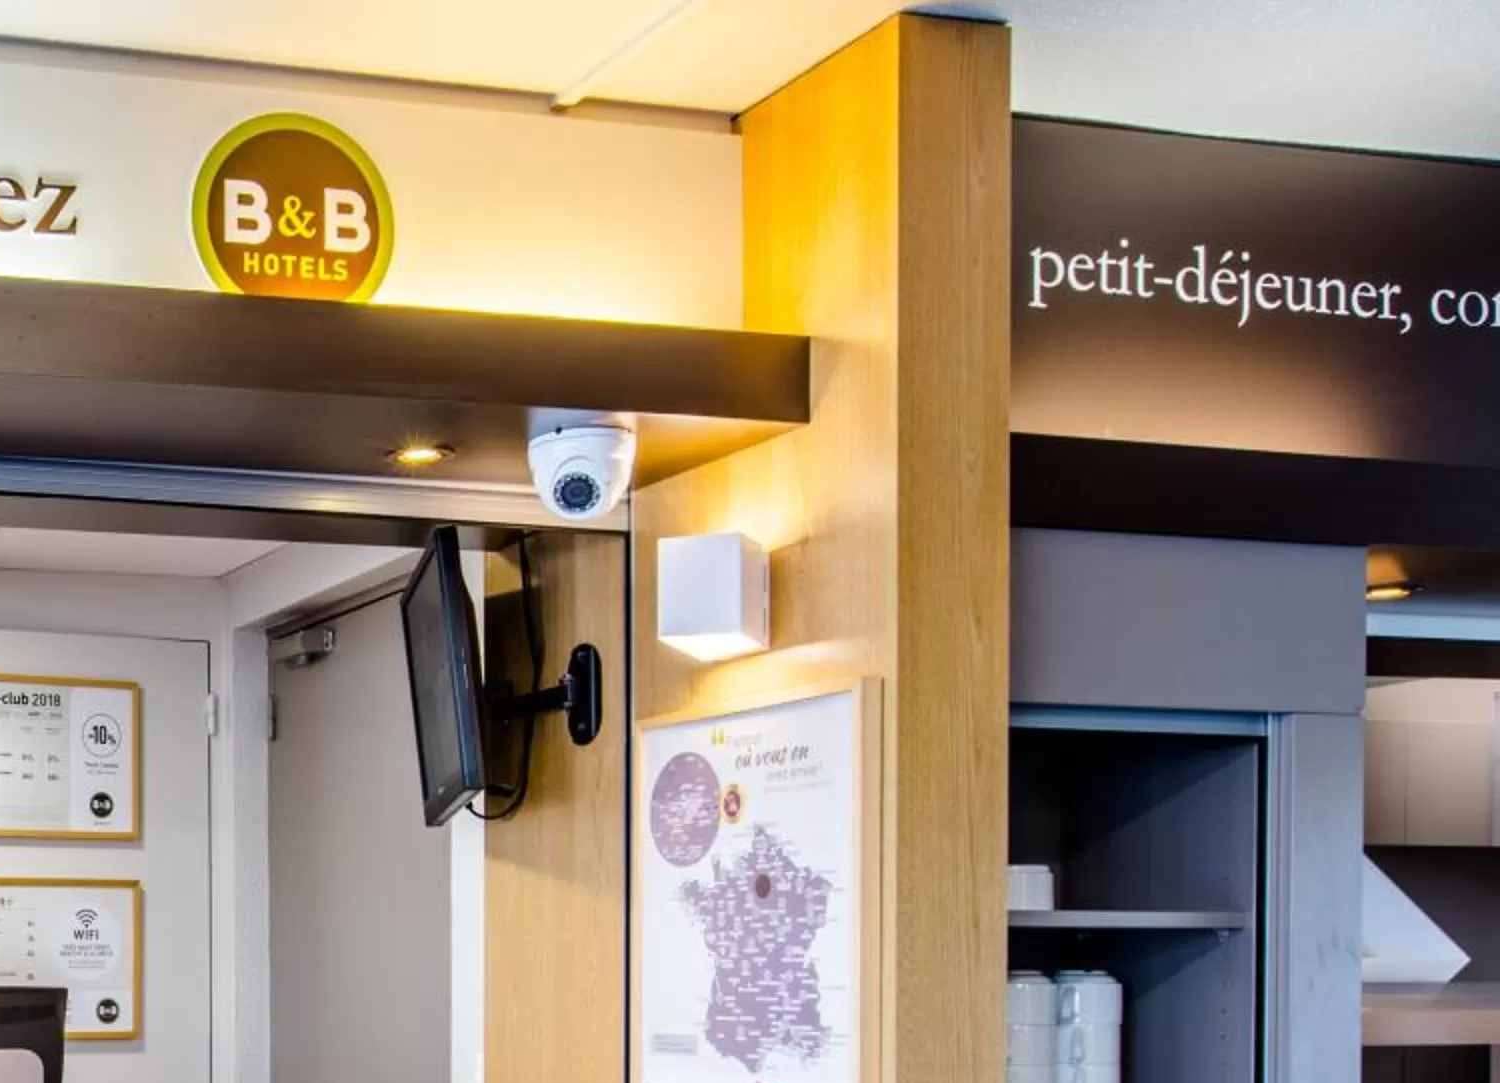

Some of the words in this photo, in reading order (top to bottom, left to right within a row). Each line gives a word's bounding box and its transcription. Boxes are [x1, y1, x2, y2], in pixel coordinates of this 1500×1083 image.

[223, 178, 372, 253] B&B
[243, 252, 349, 281] HOTELS
[1028, 238, 1413, 334] petit-déjeuner,
[31, 693, 62, 708] 2018
